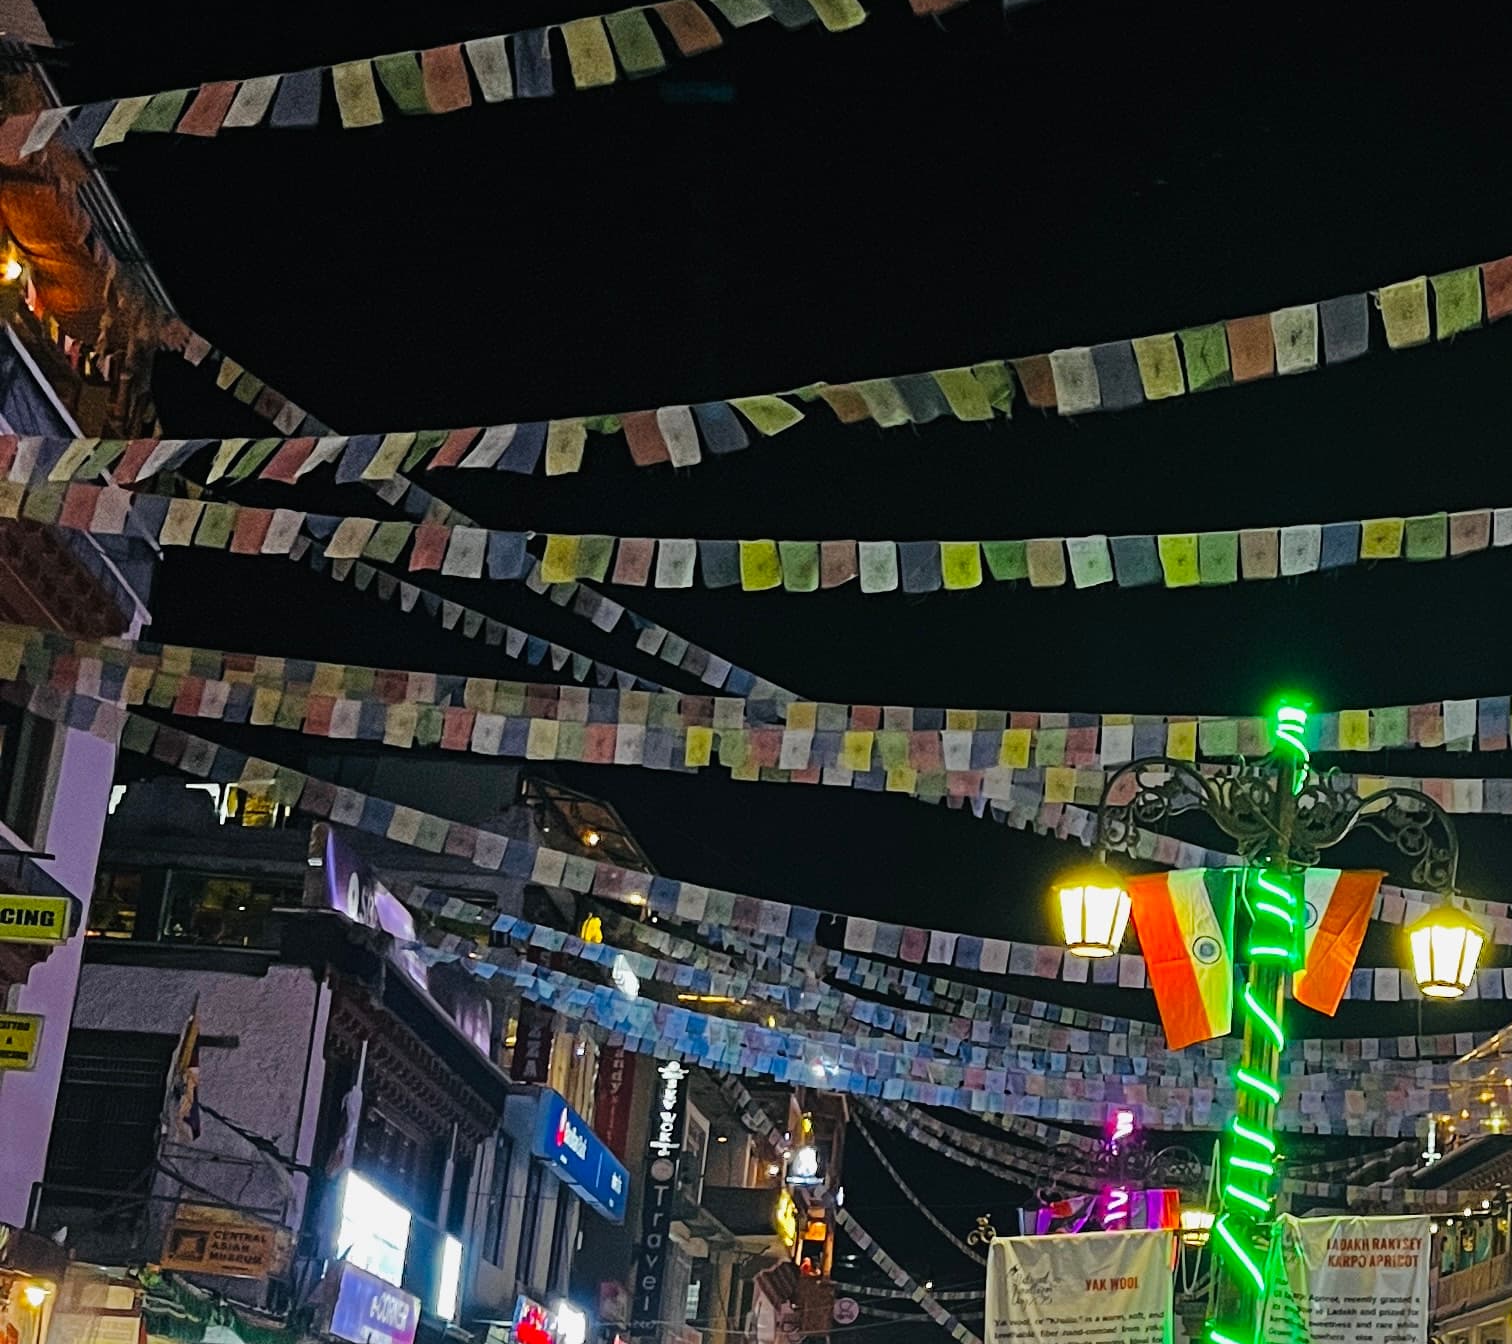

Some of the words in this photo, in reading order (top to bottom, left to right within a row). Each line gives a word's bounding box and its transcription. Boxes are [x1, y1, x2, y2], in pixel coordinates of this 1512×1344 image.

[213, 1230, 267, 1243] CENTRAL
[211, 1241, 250, 1252] ASIAN
[641, 1185, 670, 1312] Travel
[1086, 1279, 1107, 1291] YAK
